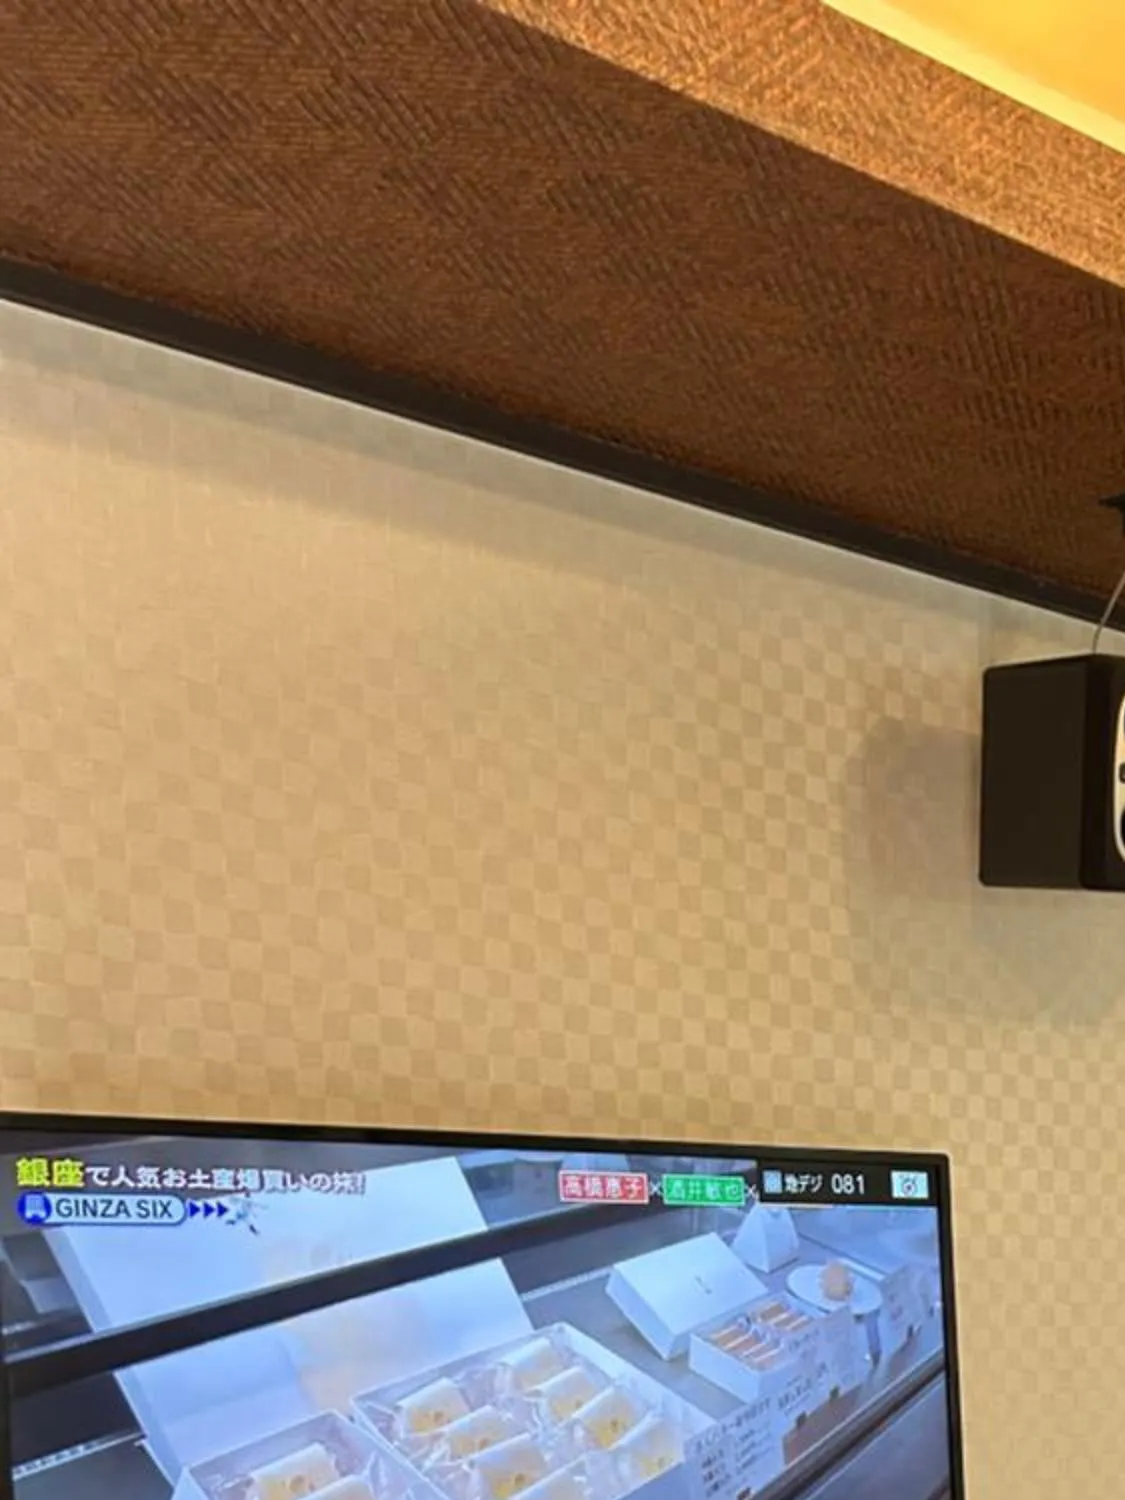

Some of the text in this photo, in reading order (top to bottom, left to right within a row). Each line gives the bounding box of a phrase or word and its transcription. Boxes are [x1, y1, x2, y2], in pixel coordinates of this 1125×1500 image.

[831, 1173, 866, 1195] 081
[55, 1198, 173, 1219] GINZA SIX
